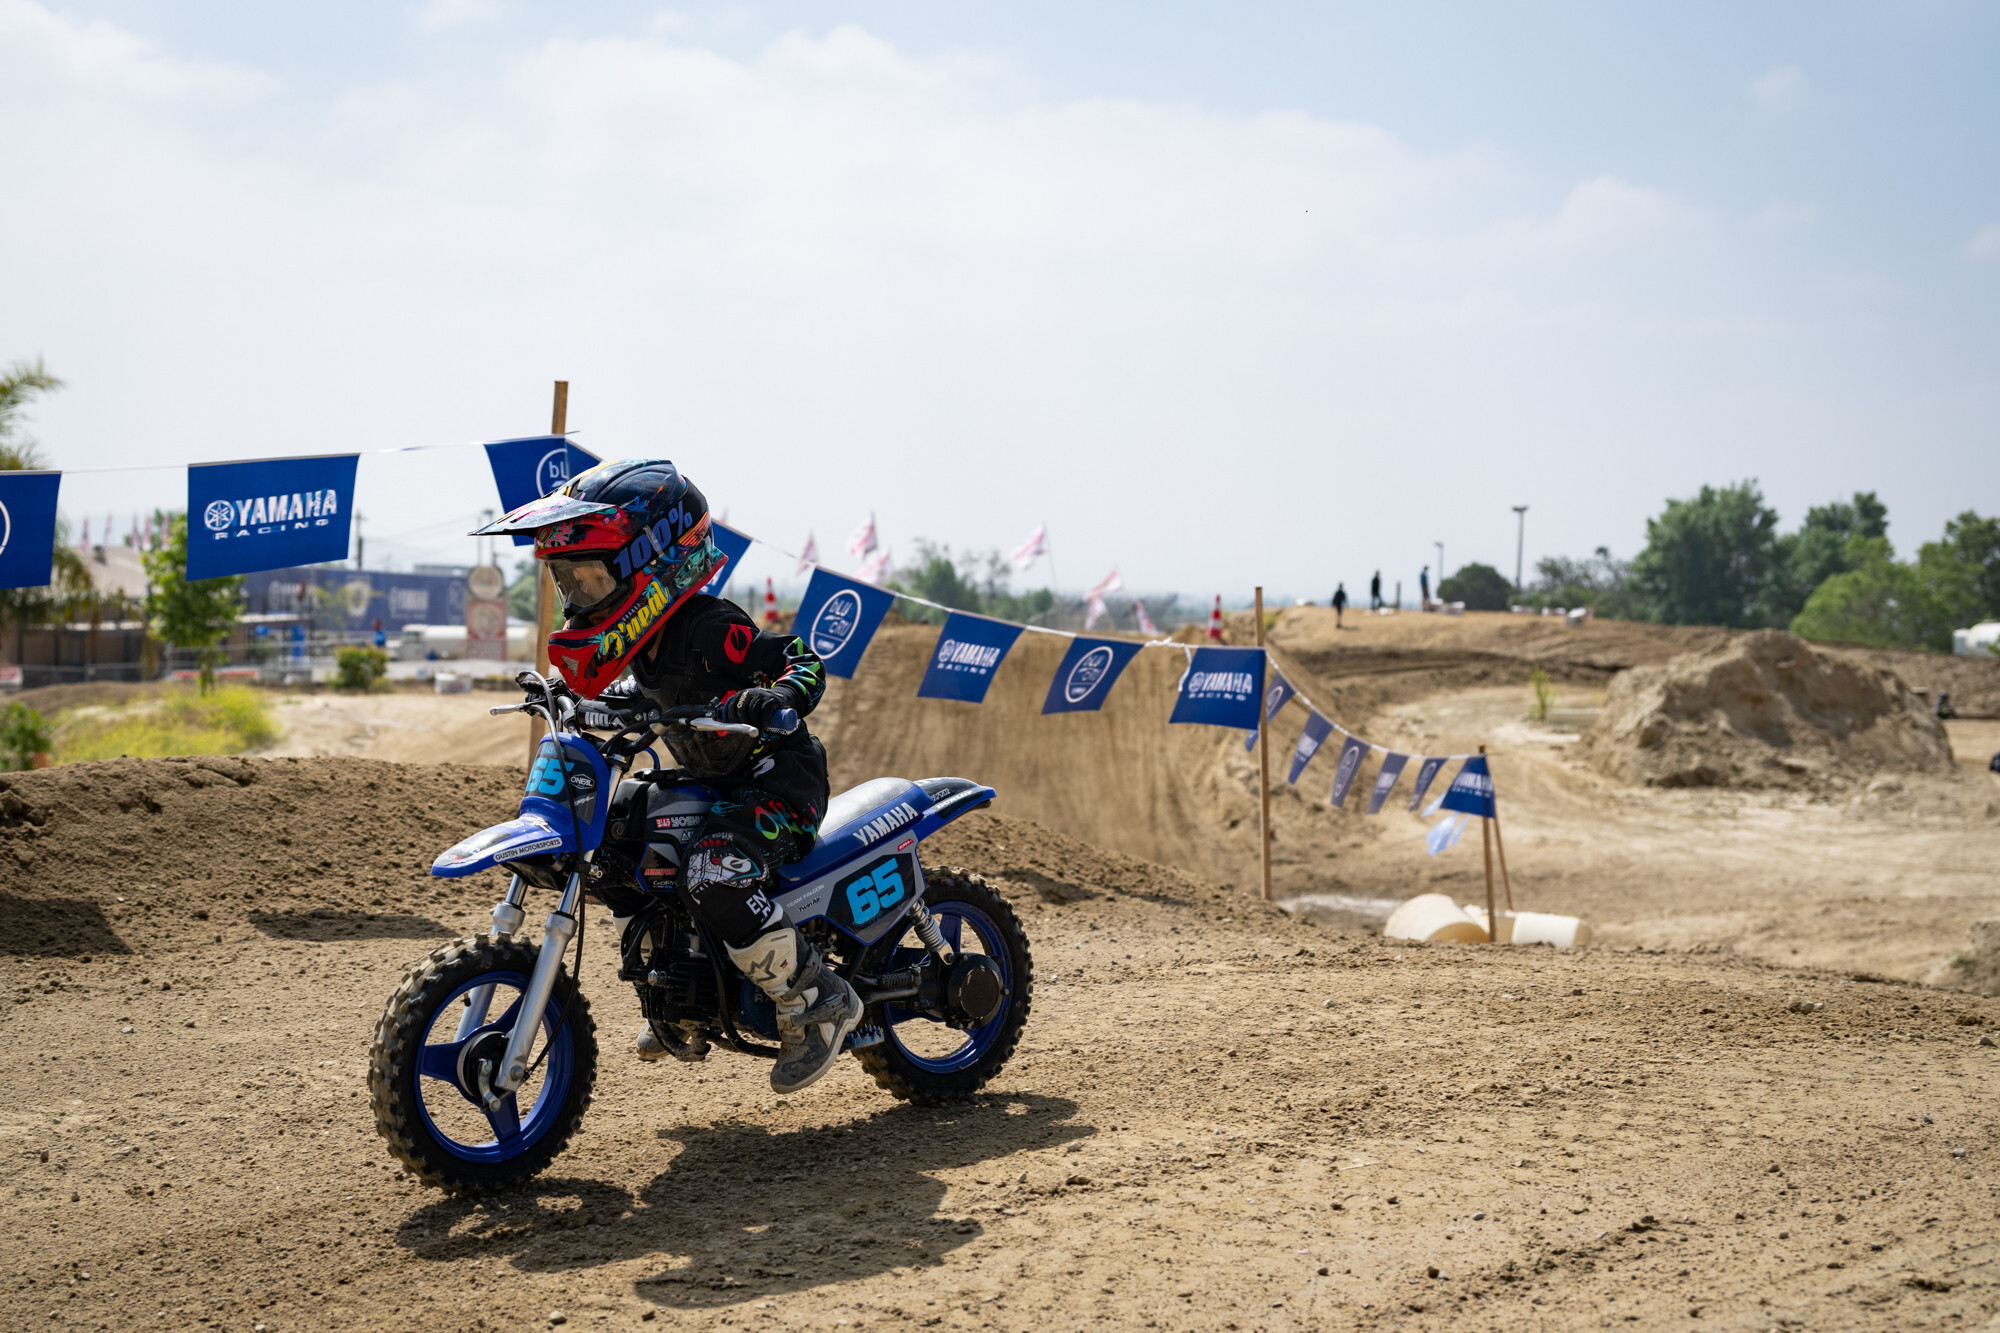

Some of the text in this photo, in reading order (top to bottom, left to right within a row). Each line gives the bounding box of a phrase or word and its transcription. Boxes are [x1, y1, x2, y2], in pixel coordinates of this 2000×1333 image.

[236, 489, 337, 526] YAMAHA
[214, 519, 329, 540] RACING
[613, 500, 693, 579] 100%
[951, 641, 1001, 668] YAMAHA
[937, 662, 987, 675] RACING
[1202, 672, 1253, 694] YAMAHA
[1188, 692, 1247, 701] RACING
[526, 757, 575, 795] 65
[571, 776, 593, 787] ONEAL
[853, 802, 919, 847] YAMAHA
[495, 839, 561, 861] GUSTIN MOTORSPORTS
[786, 884, 825, 909] TEAM FALCON
[846, 857, 905, 925] 65
